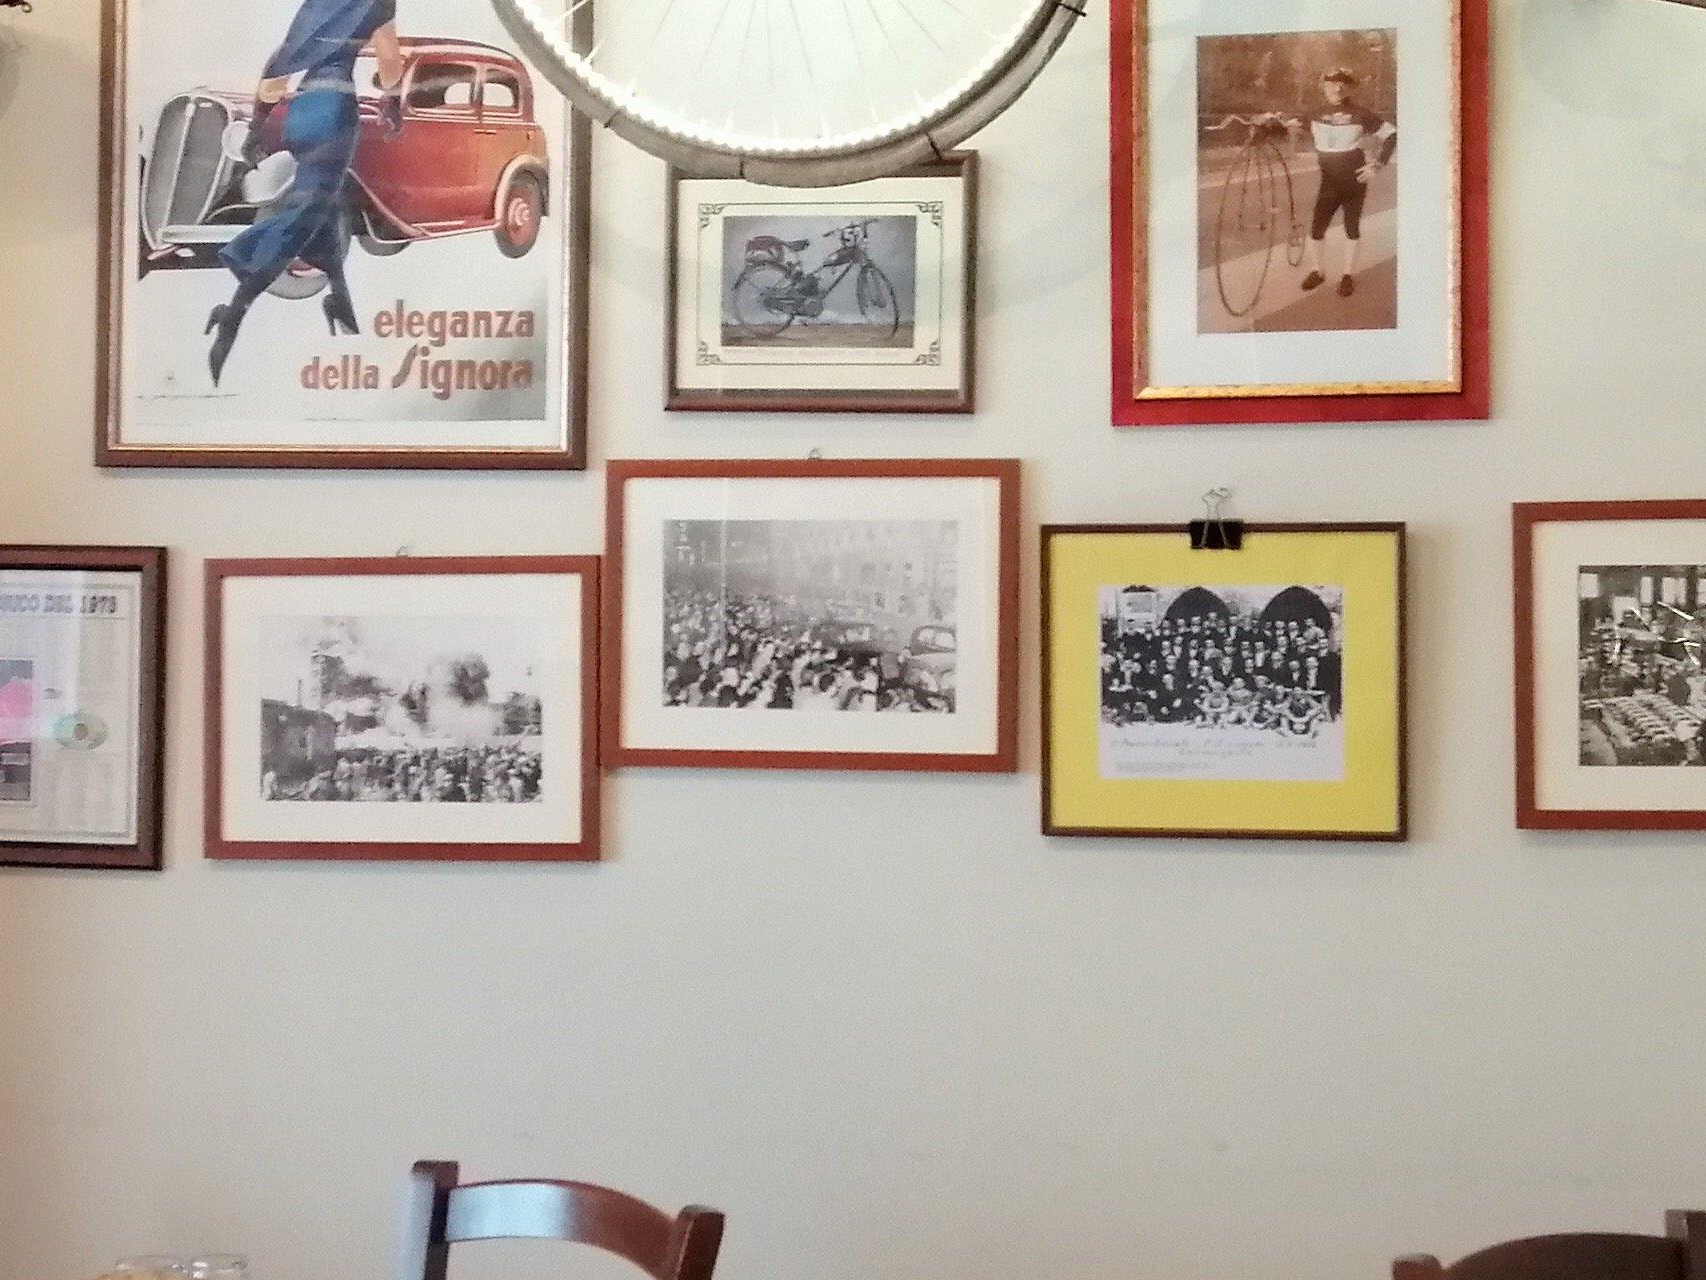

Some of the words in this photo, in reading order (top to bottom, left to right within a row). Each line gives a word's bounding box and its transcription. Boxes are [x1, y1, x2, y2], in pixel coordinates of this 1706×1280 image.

[373, 299, 535, 348] eleganza
[300, 355, 380, 389] della
[391, 344, 533, 401] Signora
